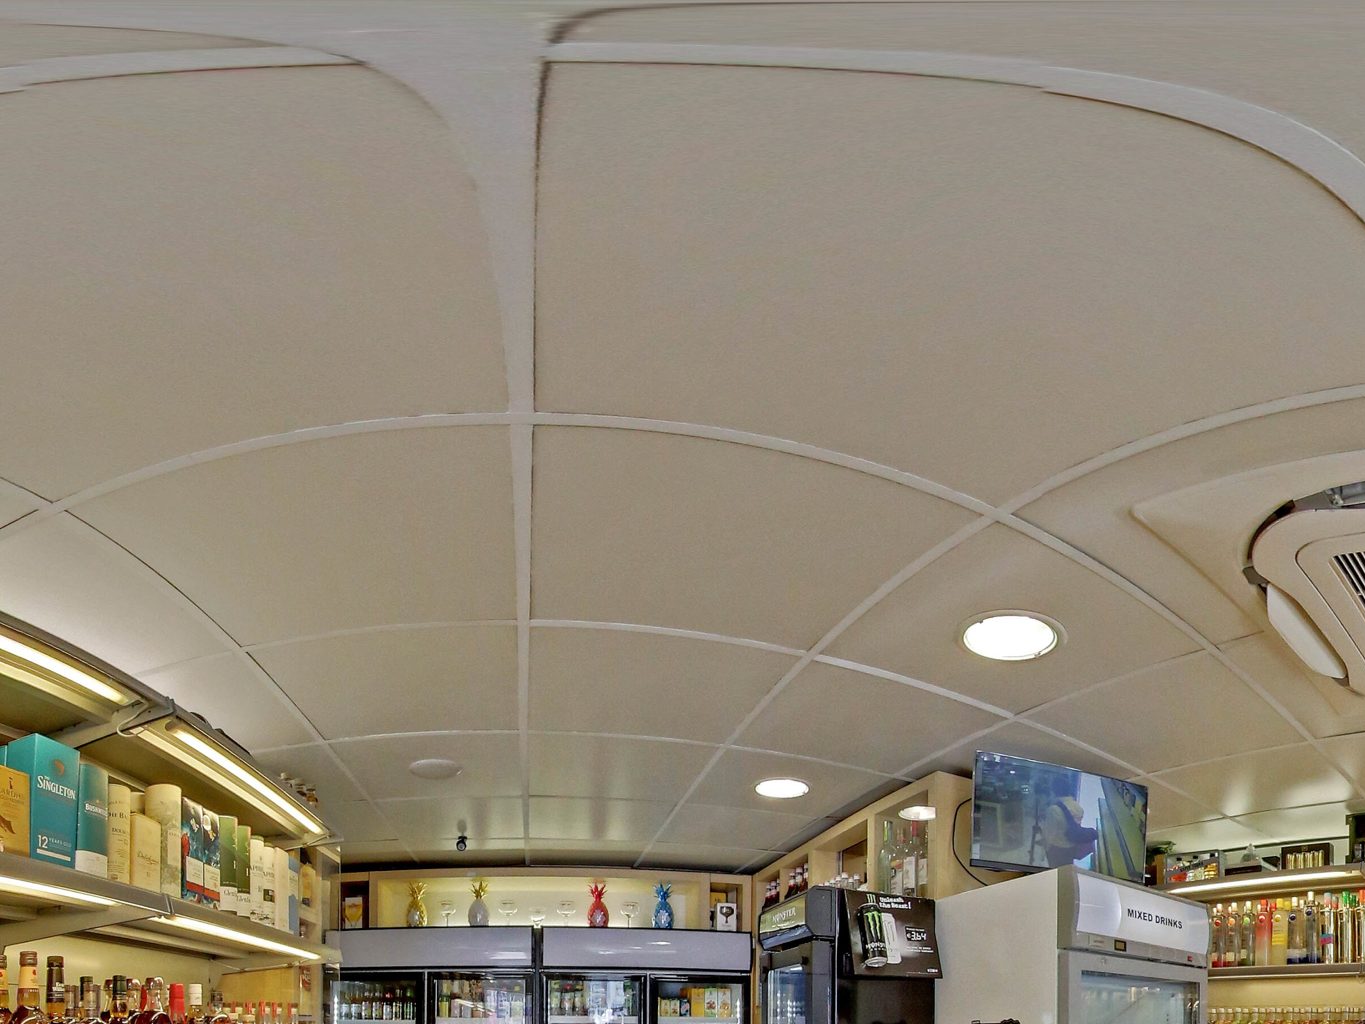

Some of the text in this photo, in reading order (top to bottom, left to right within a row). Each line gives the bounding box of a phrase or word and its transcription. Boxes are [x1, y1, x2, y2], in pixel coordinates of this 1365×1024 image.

[37, 775, 76, 800] SINGLETON
[37, 834, 49, 848] 12
[1127, 907, 1183, 929] MIXED DRINKS
